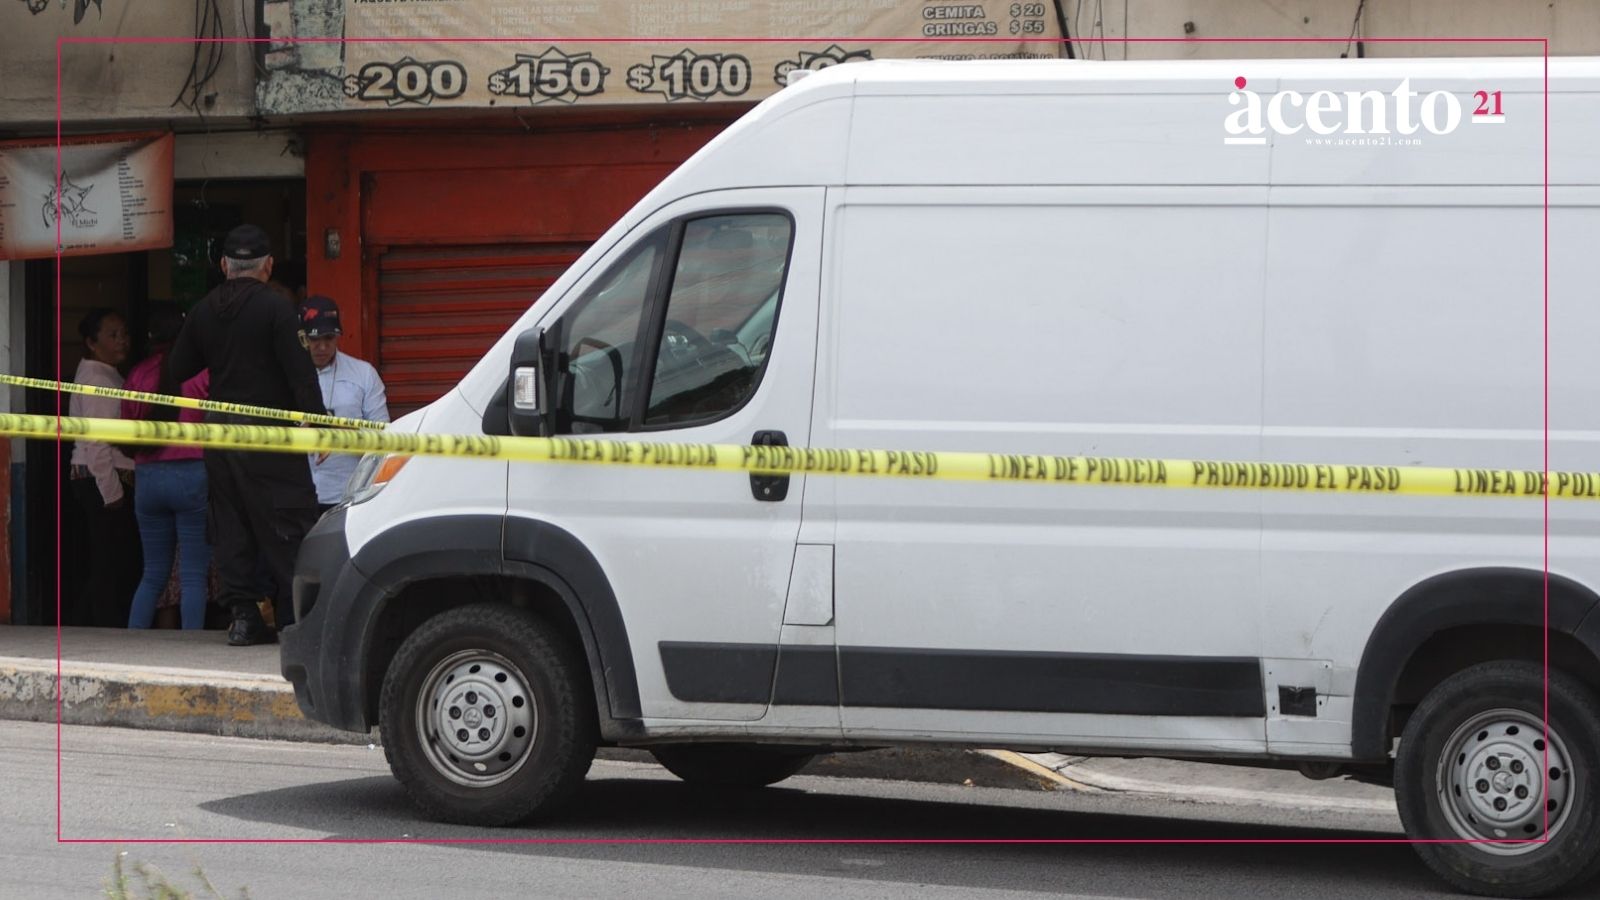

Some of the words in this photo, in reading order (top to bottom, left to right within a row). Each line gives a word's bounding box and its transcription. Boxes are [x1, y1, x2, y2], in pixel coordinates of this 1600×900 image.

[923, 5, 986, 20] CEMITA
[1010, 3, 1021, 17] $
[1023, 3, 1046, 17] 20
[923, 21, 998, 36] GRINGAS
[1010, 19, 1021, 35] $
[1022, 19, 1046, 34] 55
[342, 61, 467, 100] $200
[488, 59, 607, 97] $150
[627, 55, 752, 98] $100
[452, 434, 501, 456] PASO
[547, 437, 603, 460] LINEA
[610, 440, 634, 463] DE
[638, 441, 718, 467] POLICIA
[741, 446, 852, 473] PROHIBIDO
[857, 449, 878, 474] EL
[885, 450, 939, 476] PASO
[989, 453, 1049, 480] LINEA
[1054, 457, 1080, 482] DE
[1085, 457, 1168, 485] POLICIA
[1193, 461, 1310, 489] PROHIBIDO
[1315, 465, 1339, 490] EL
[1345, 465, 1401, 491] PASO
[1454, 469, 1516, 495] LINEA
[1523, 471, 1548, 495] DE
